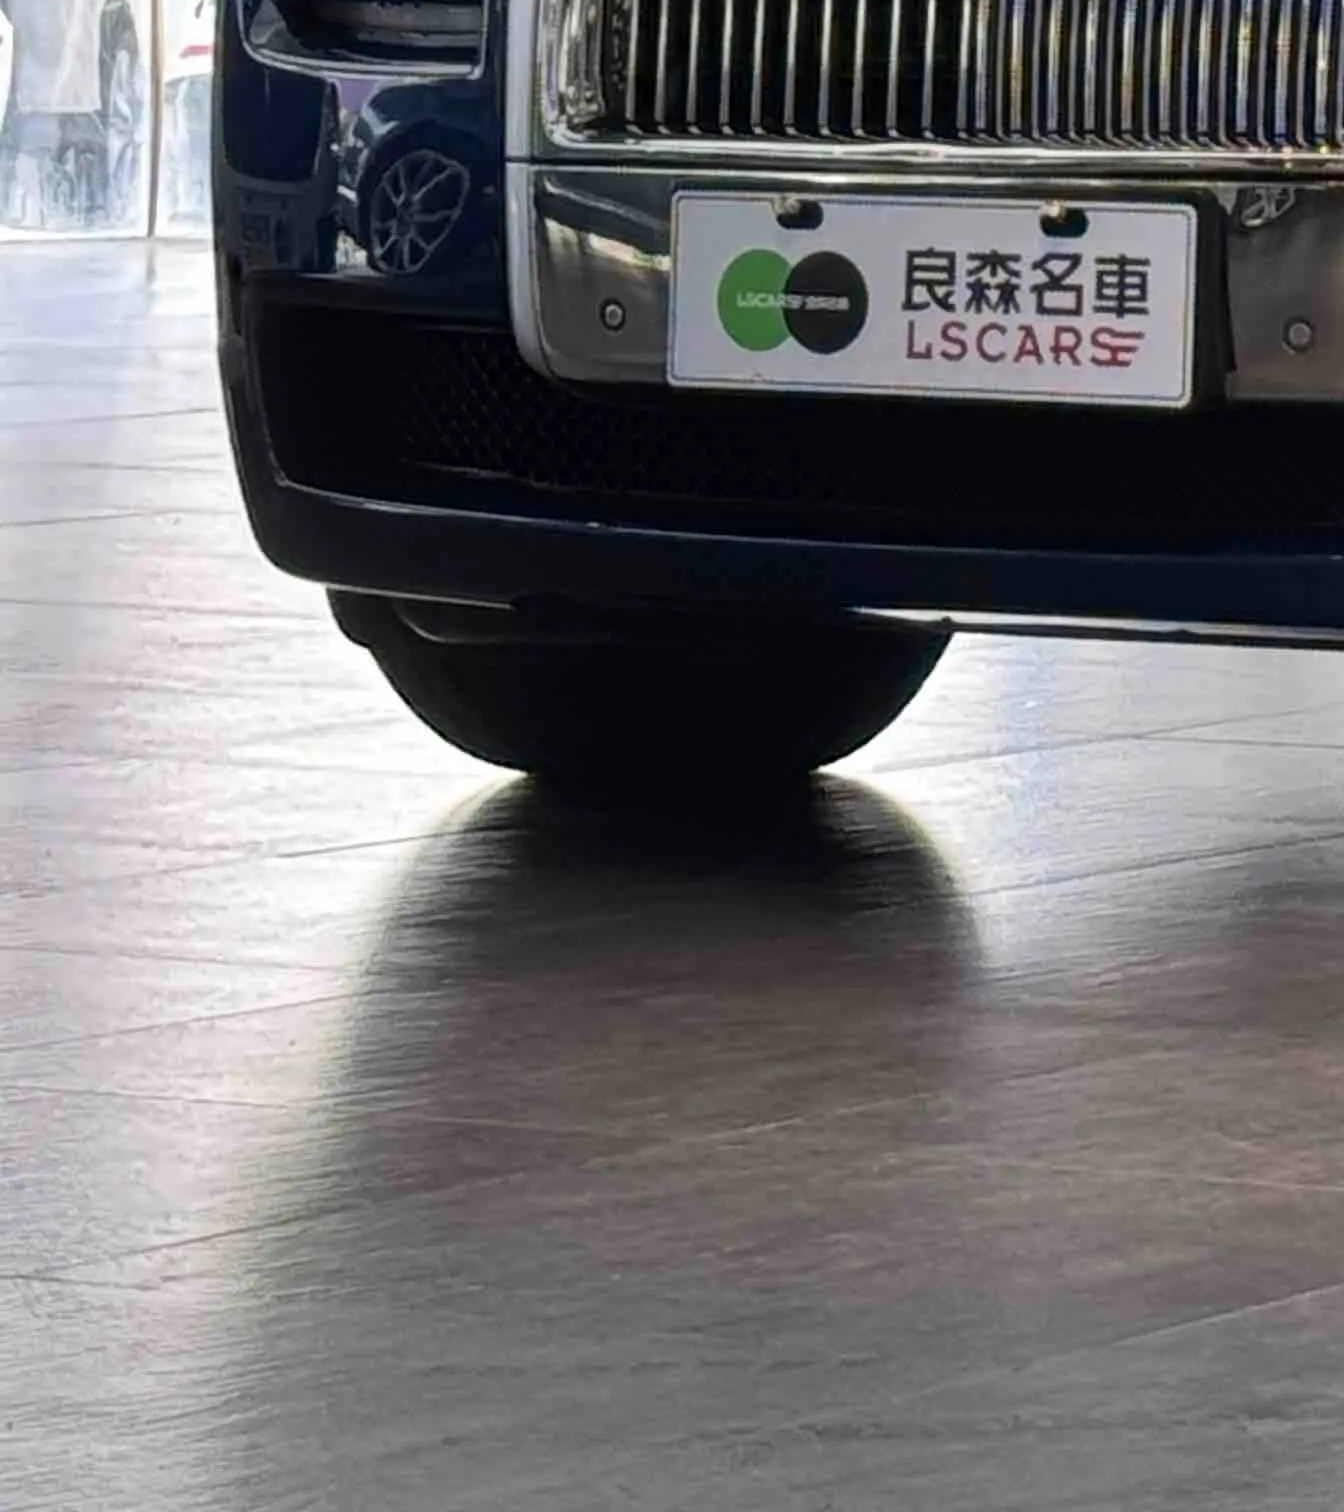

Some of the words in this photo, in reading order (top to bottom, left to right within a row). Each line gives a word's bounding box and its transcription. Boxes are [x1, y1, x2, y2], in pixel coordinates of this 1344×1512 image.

[901, 247, 1151, 319] 良森名車
[906, 320, 1145, 368] LSCARS
